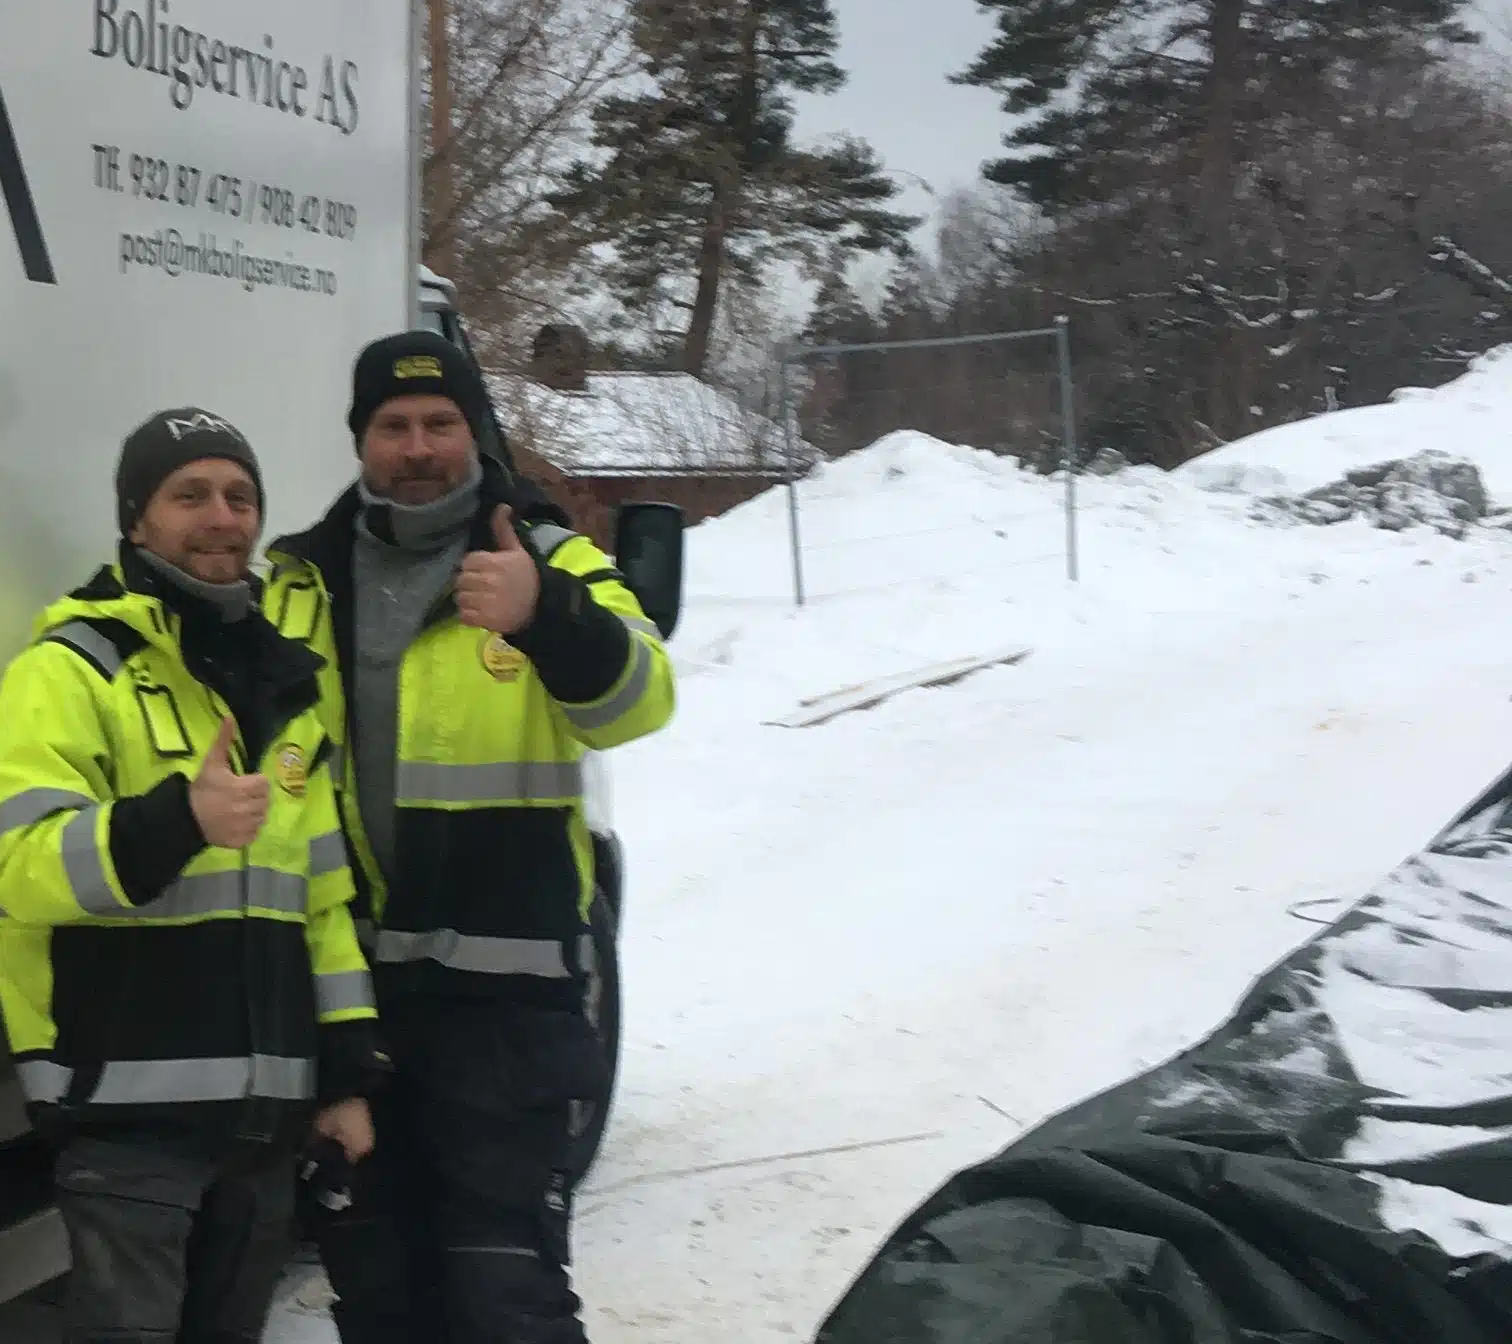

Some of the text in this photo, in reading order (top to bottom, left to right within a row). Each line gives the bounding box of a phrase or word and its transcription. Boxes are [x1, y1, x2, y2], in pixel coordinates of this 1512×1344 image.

[313, 53, 359, 136] AS
[129, 152, 170, 203] 932
[174, 163, 202, 207] 87
[205, 173, 243, 218] 475
[258, 183, 295, 229] 908
[297, 194, 321, 235] 42
[118, 227, 338, 296] post@mkboligservice.no
